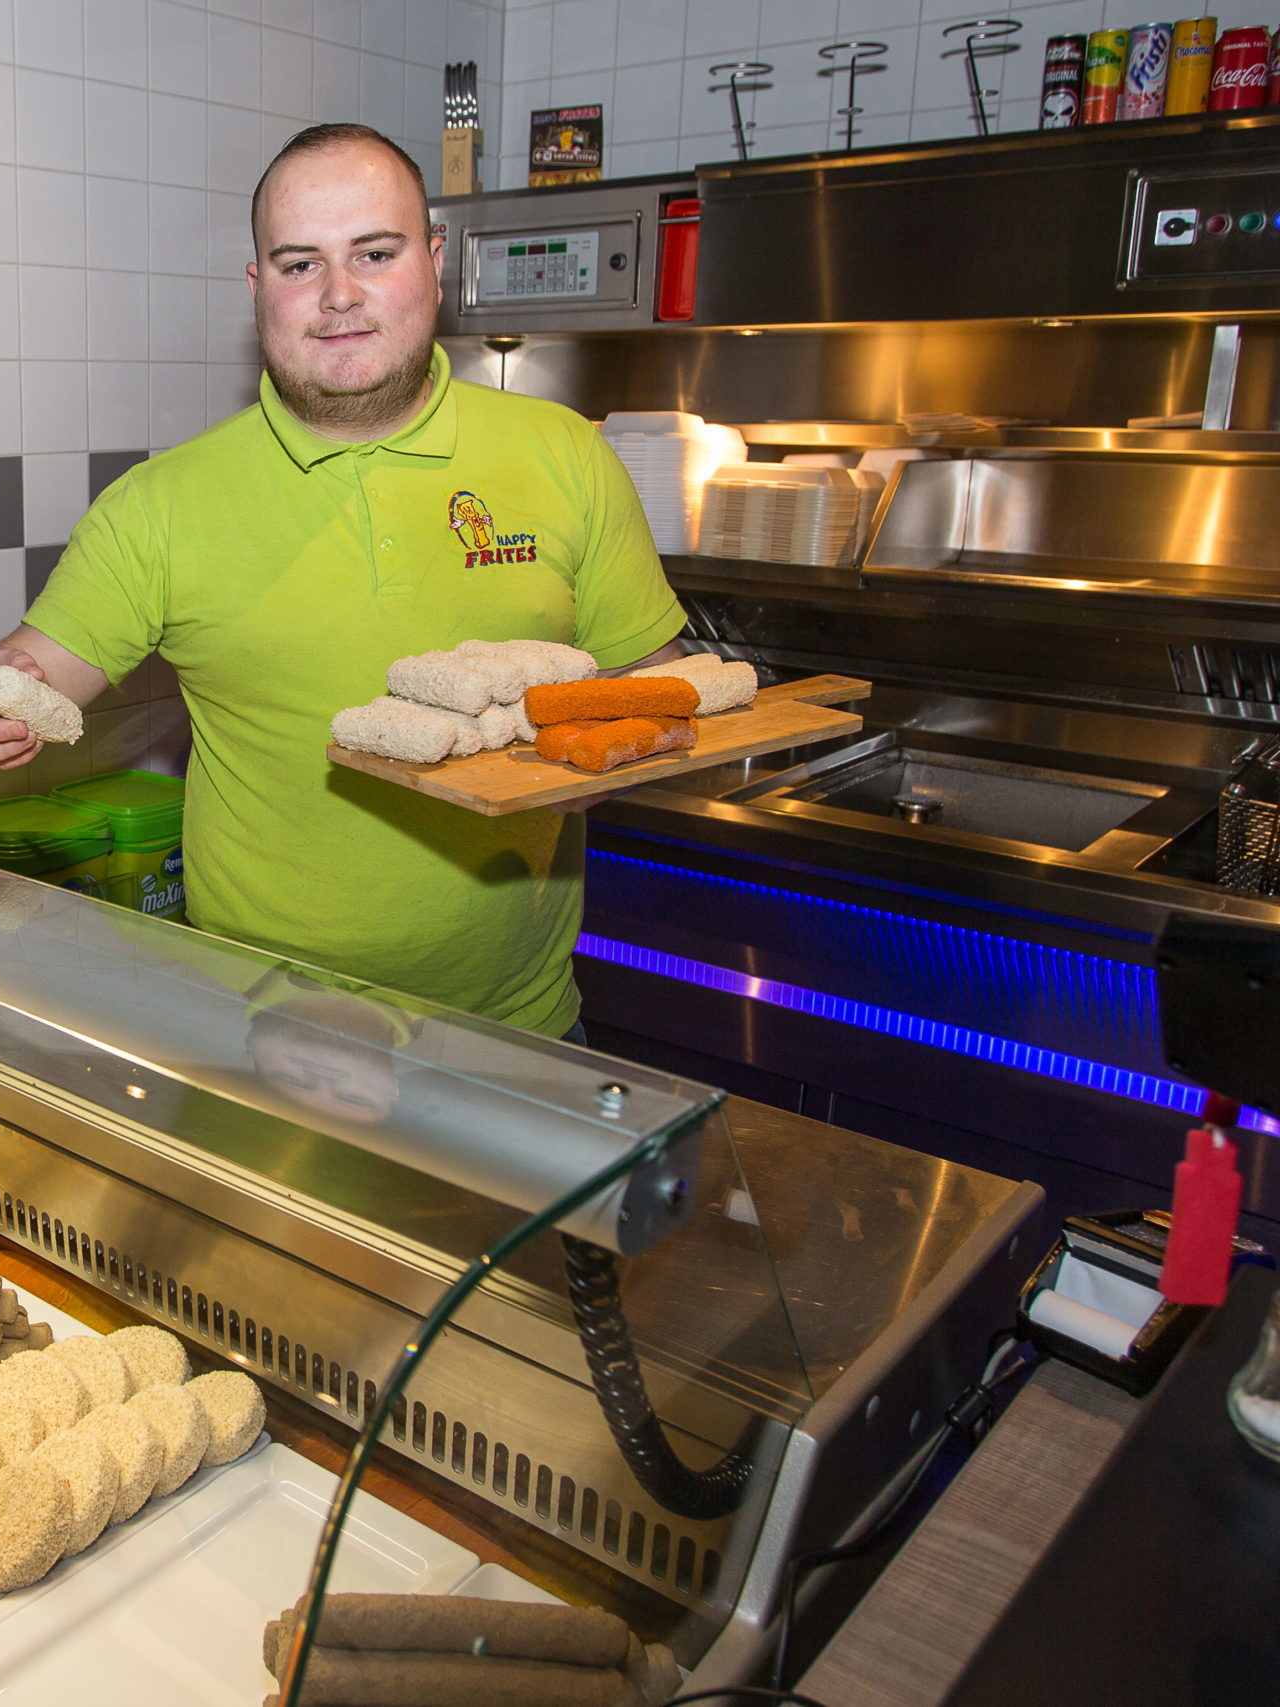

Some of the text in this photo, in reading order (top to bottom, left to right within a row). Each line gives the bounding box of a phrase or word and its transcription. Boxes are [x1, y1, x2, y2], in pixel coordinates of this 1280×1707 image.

[1130, 28, 1167, 91] Fristi
[496, 533, 536, 546] HAPPY
[465, 545, 537, 569] FRITES
[165, 858, 184, 872] Rem
